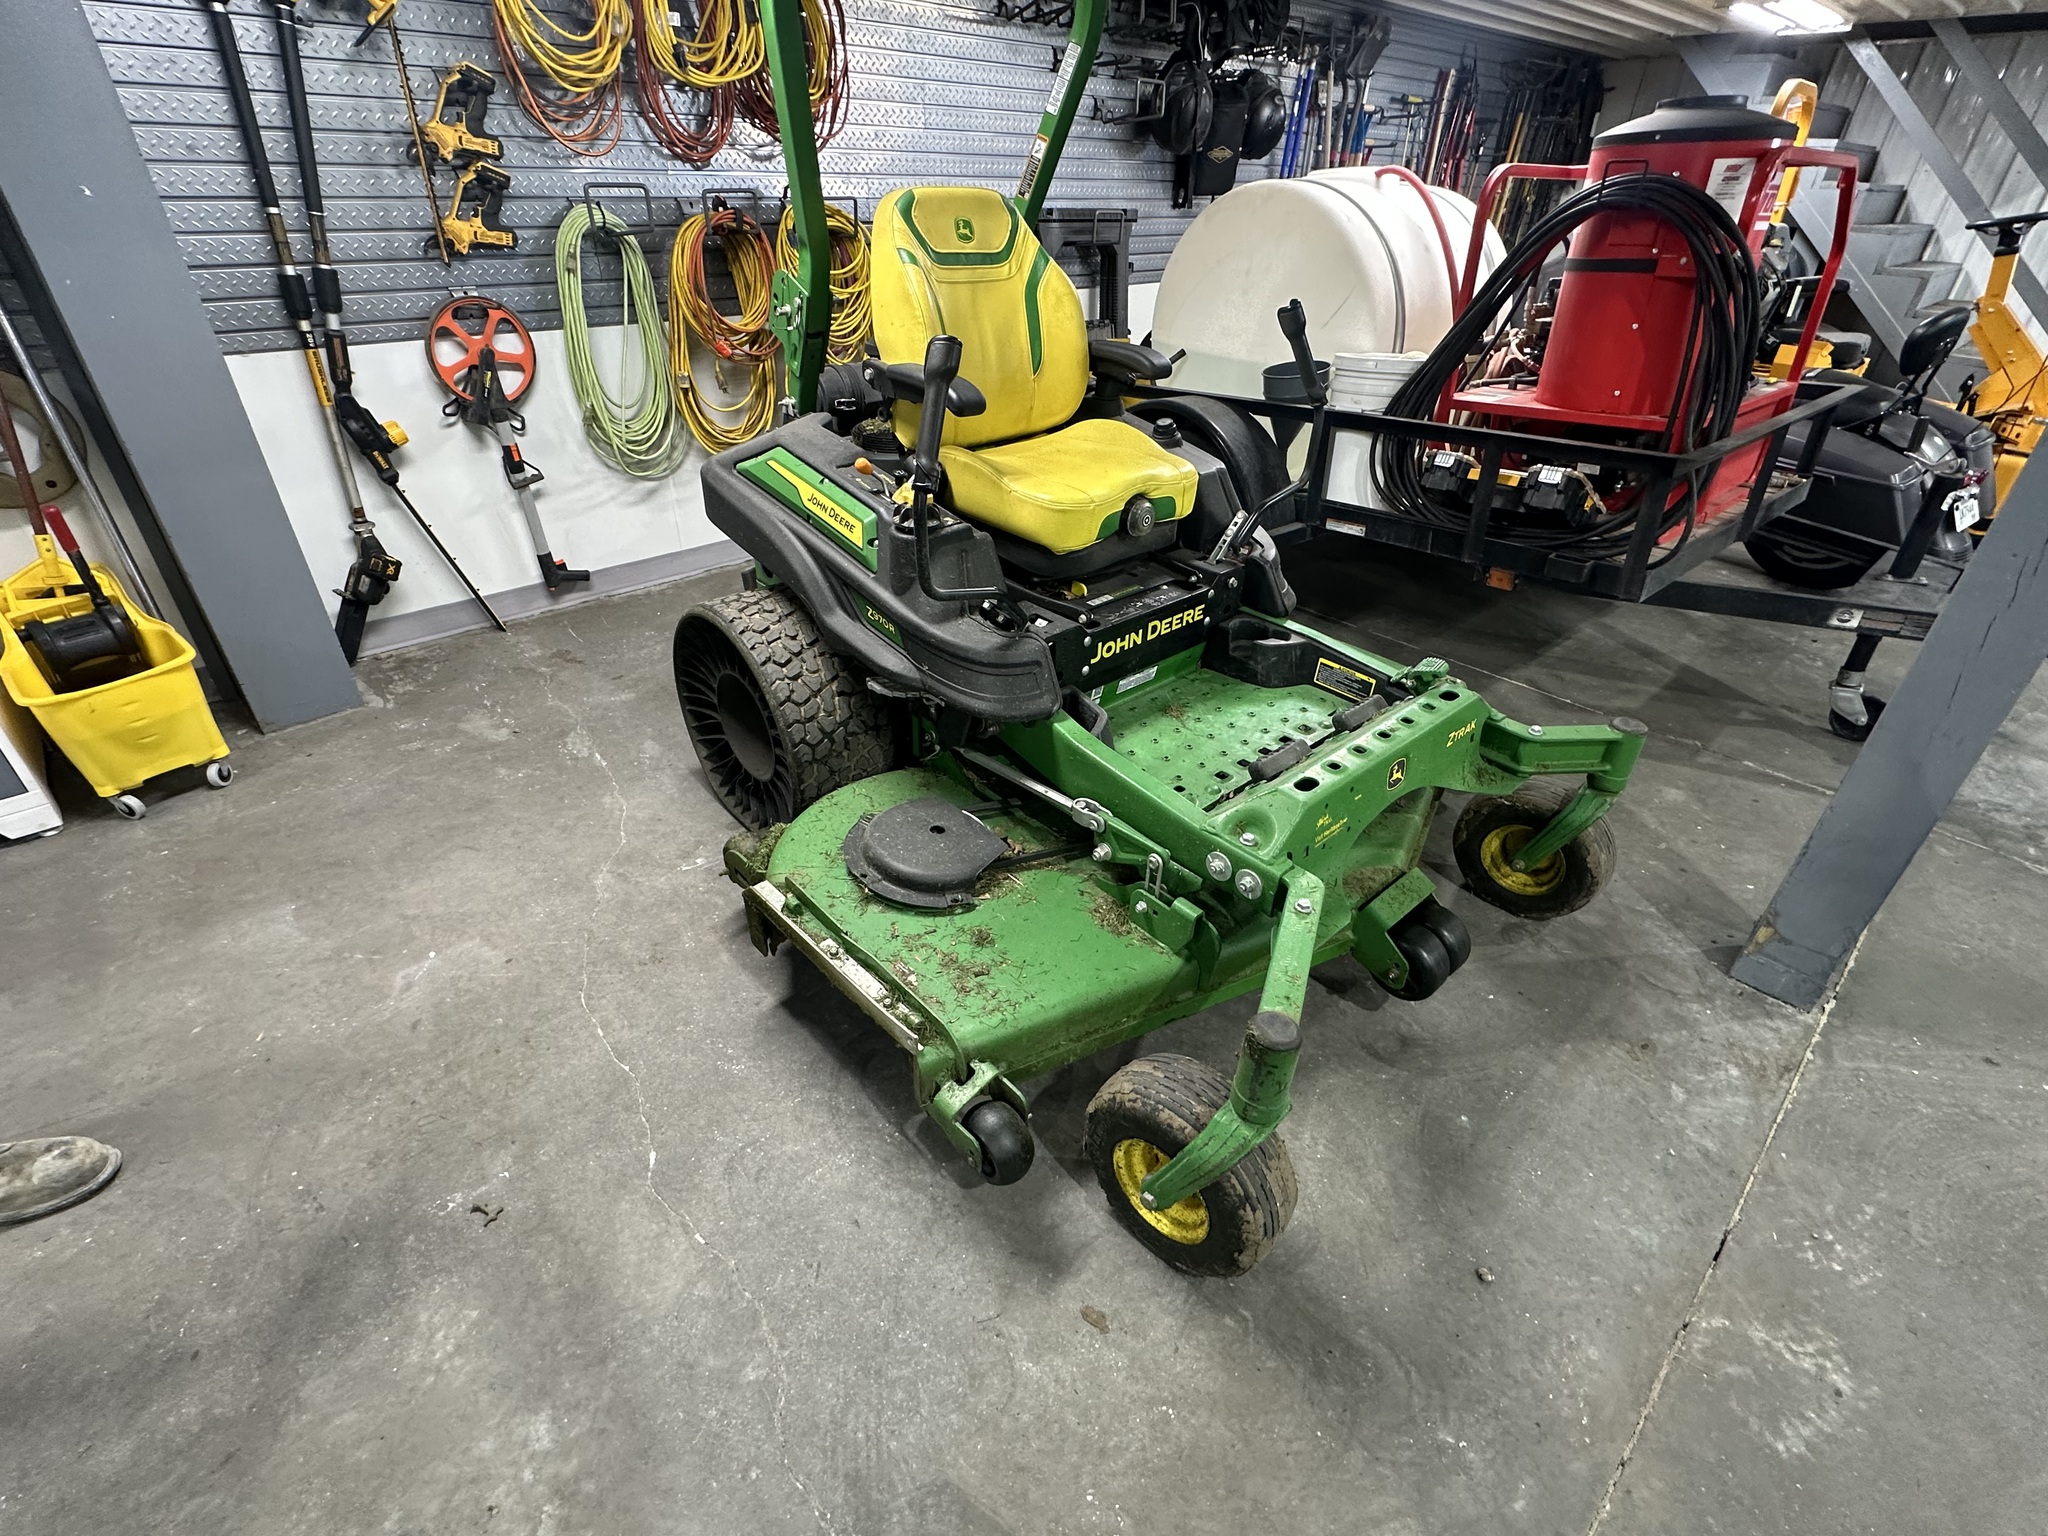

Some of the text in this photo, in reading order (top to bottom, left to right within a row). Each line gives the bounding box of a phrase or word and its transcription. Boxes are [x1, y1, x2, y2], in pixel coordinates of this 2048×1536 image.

[807, 494, 856, 533] JOHN DEERE
[865, 605, 896, 635] Z970R
[1090, 603, 1206, 665] JOHN DEERE
[1446, 718, 1478, 748] ZTRAK
